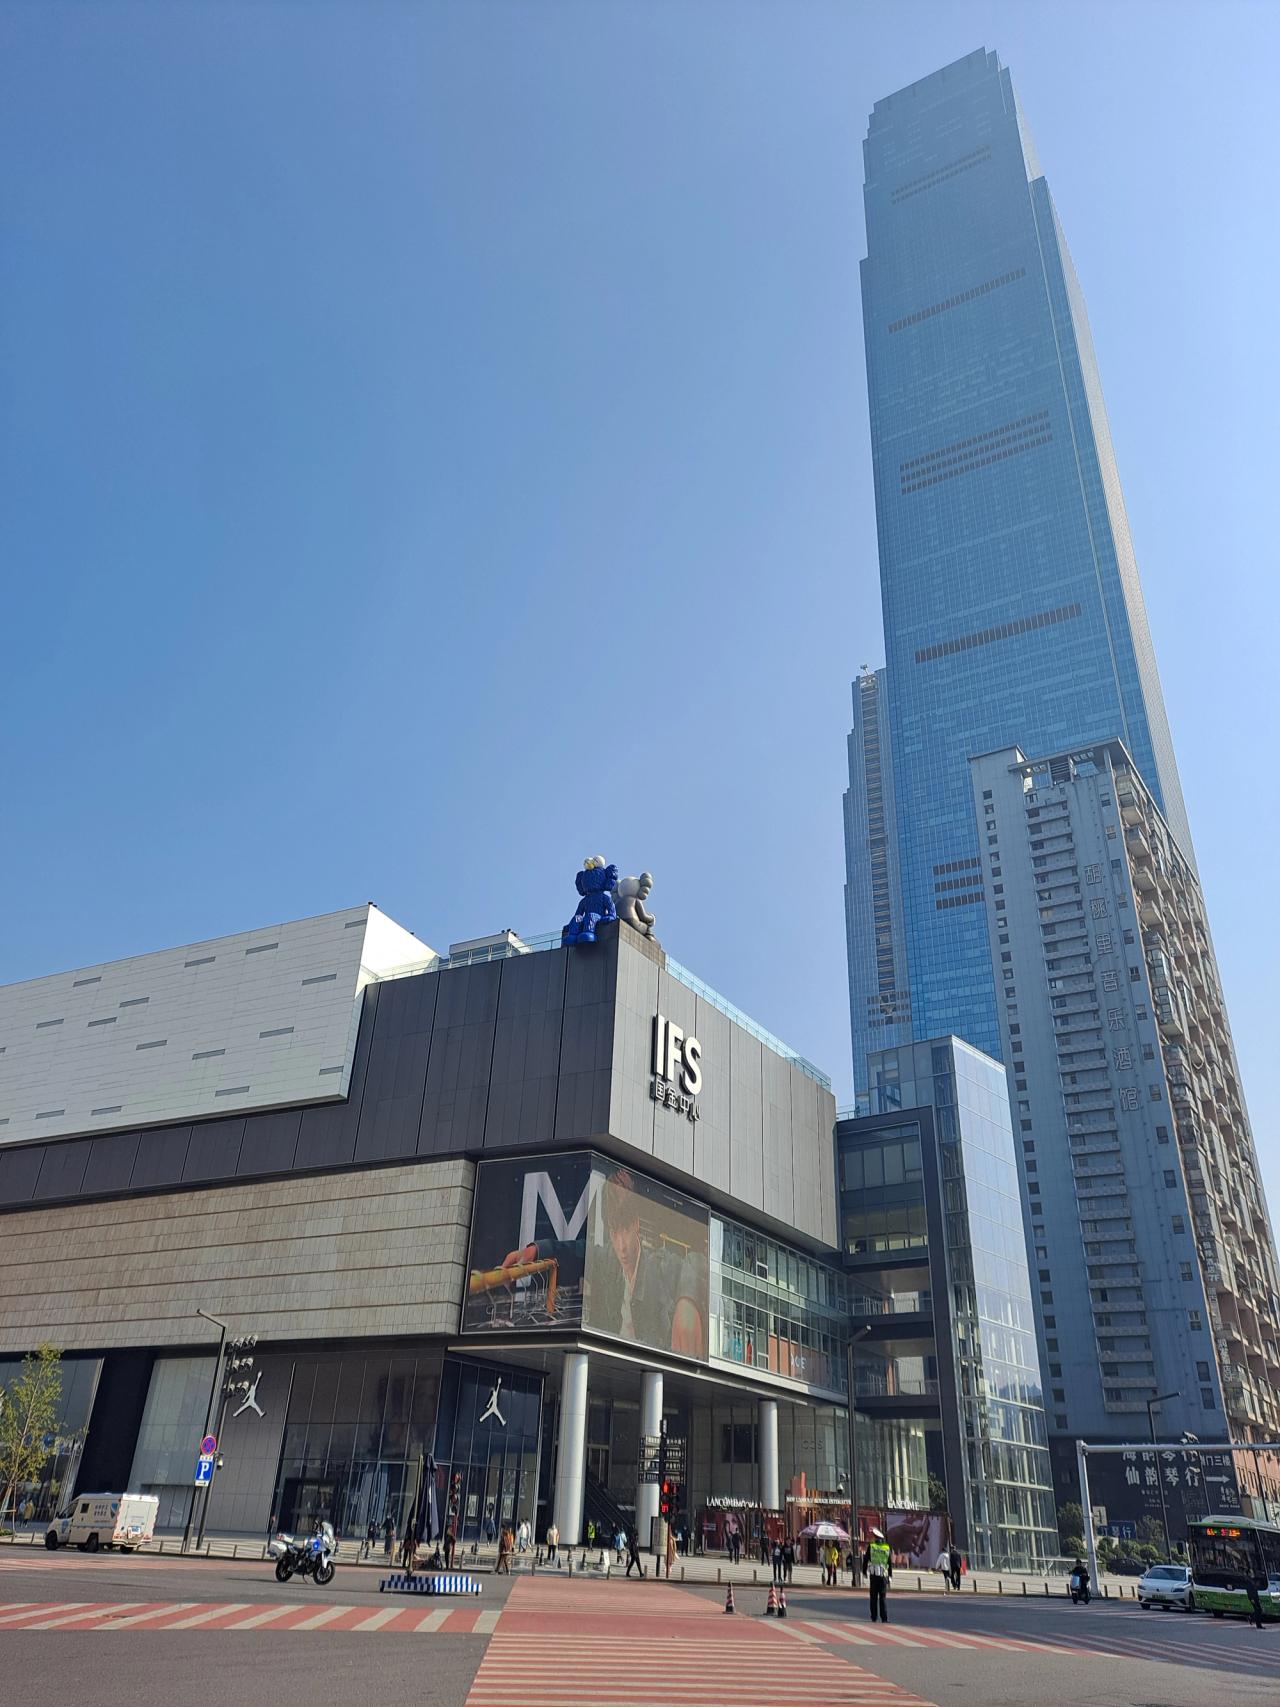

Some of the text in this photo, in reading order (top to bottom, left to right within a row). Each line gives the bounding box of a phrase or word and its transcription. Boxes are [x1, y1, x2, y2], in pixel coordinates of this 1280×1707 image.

[1084, 863, 1139, 1112] 胡桃里音乐酒馆
[653, 1014, 702, 1095] IFS
[653, 1079, 700, 1121] 国金中心
[199, 1462, 209, 1479] P
